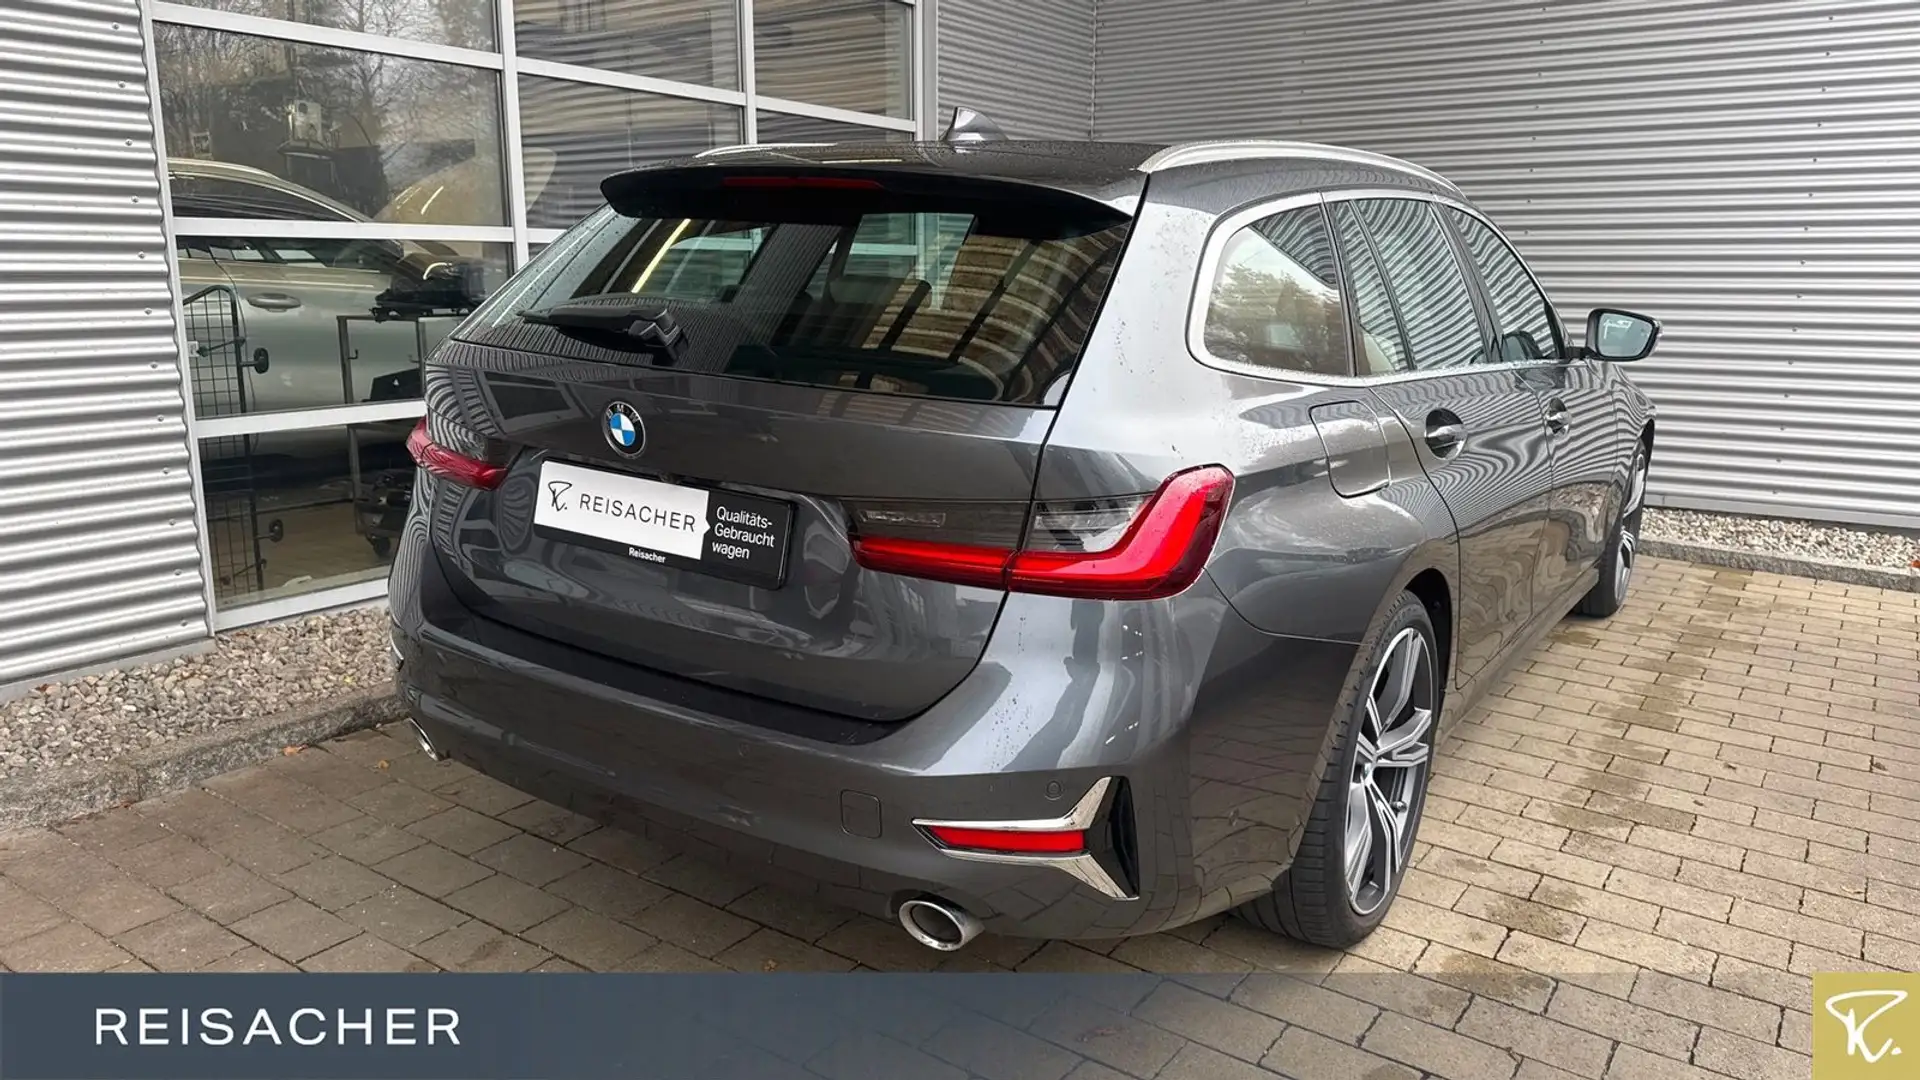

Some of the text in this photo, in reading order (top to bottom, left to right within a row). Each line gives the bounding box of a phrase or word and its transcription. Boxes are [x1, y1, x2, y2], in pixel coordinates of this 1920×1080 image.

[606, 404, 640, 423] BMW
[579, 493, 696, 533] REISACHER
[716, 506, 773, 529] Qualitäts-
[714, 524, 775, 548] Gebraucht
[628, 547, 666, 564] Reisacher
[712, 541, 750, 560] wagen
